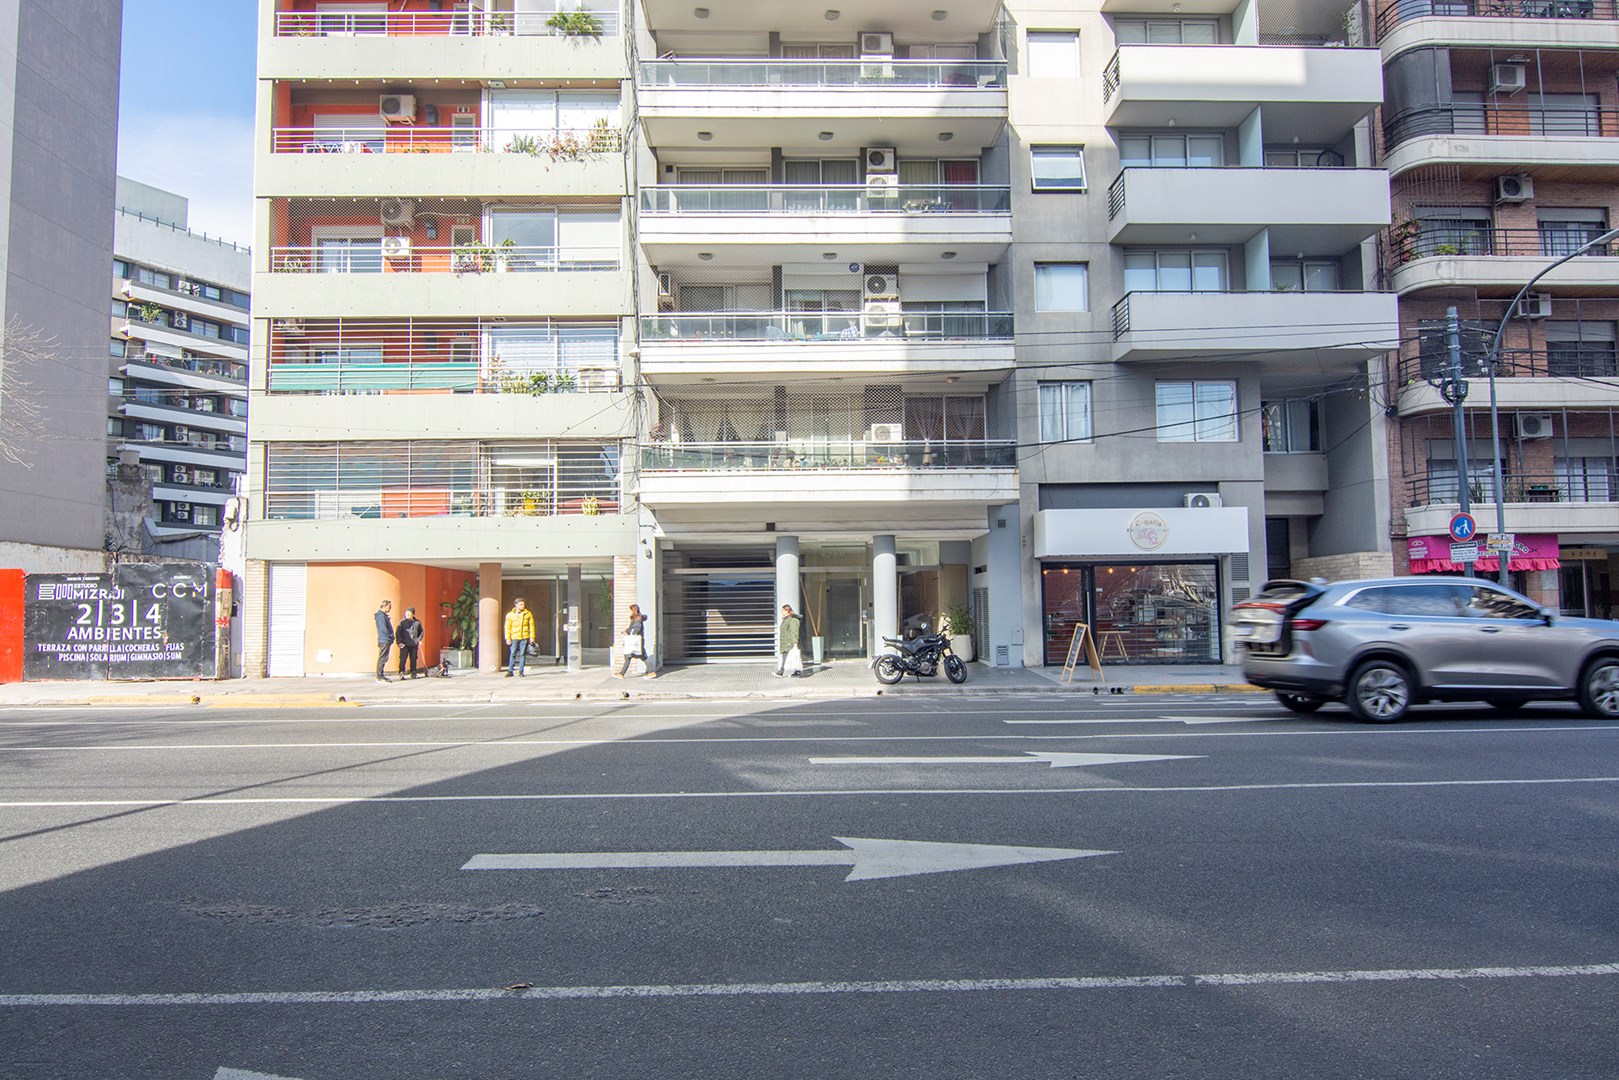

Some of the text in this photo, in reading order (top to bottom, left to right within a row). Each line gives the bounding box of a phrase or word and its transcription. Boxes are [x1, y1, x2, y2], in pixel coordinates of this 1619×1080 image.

[73, 588, 124, 600] MIZRAJI
[66, 626, 162, 641] AMBIENTES
[37, 643, 71, 652] TERRAZA
[73, 644, 87, 652] CON
[165, 642, 185, 651] FIJAS
